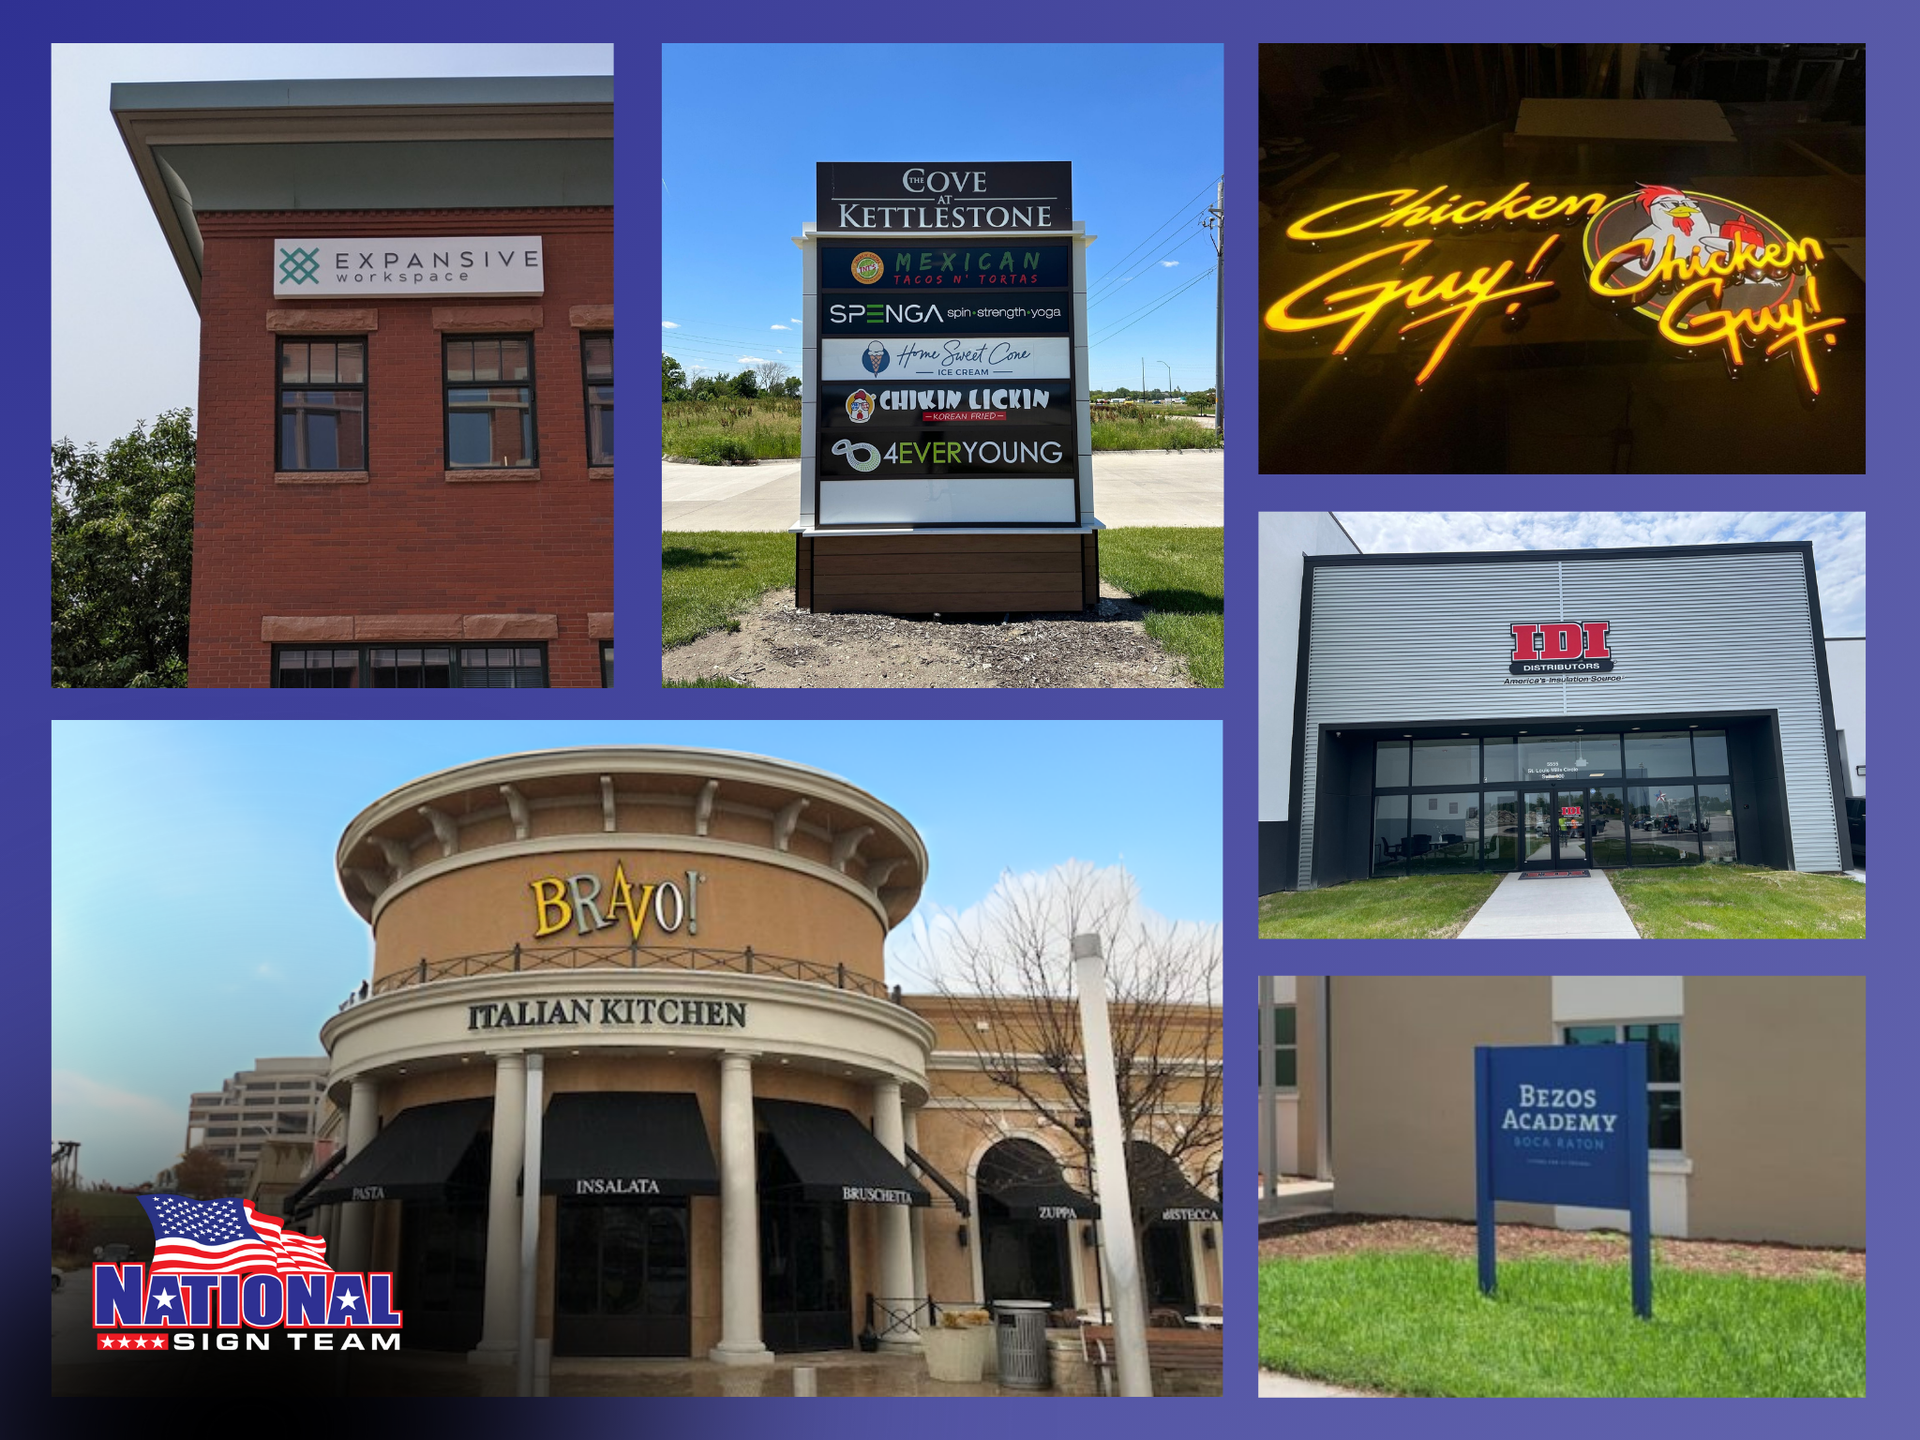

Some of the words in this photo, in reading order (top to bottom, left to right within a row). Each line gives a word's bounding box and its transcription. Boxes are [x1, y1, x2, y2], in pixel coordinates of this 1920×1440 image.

[902, 168, 987, 193] COVE
[908, 176, 924, 184] THE
[937, 195, 953, 205] AT
[838, 203, 1052, 229] KETTLESTONE
[1286, 182, 1607, 240] Chicken
[335, 250, 539, 269] EXPANSIVE
[895, 251, 1041, 273] MEXICAN
[1589, 235, 1825, 297] Chicken
[336, 272, 469, 284] workspace
[893, 275, 943, 286] TACOS
[979, 274, 1039, 285] TORTAS
[830, 304, 944, 324] SPENGA
[1265, 234, 1560, 385] Guy!
[1658, 276, 1846, 396] Guy!
[897, 342, 941, 368] Home
[942, 340, 988, 367] Sweet
[988, 341, 1032, 366] Cone
[955, 368, 989, 376] CREAM
[879, 389, 962, 411] CHIKIN
[968, 388, 1050, 410] LICKIN
[933, 412, 968, 421] KOREAN
[970, 411, 996, 420] FRIED
[883, 441, 1063, 465] 4EVERYOUNG
[1511, 622, 1610, 661] IDI
[1523, 663, 1600, 671] DISTRIBUTORS
[1503, 677, 1546, 685] America's
[1548, 675, 1589, 683] Insulation
[1561, 806, 1581, 815] IDI
[530, 859, 698, 940] BRAVO!
[468, 999, 594, 1030] ITALIAN
[600, 1000, 748, 1028] KITCHEN
[1519, 1084, 1597, 1108] BEZOS
[1501, 1109, 1617, 1132] ACADEMY
[1514, 1136, 1550, 1147] BOCA
[1557, 1138, 1604, 1150] RATON
[352, 1186, 385, 1201] PASTA
[576, 1179, 660, 1194] INSALATA
[842, 1186, 913, 1204] BRUSCHETTA
[1038, 1206, 1077, 1220] ZUPPA
